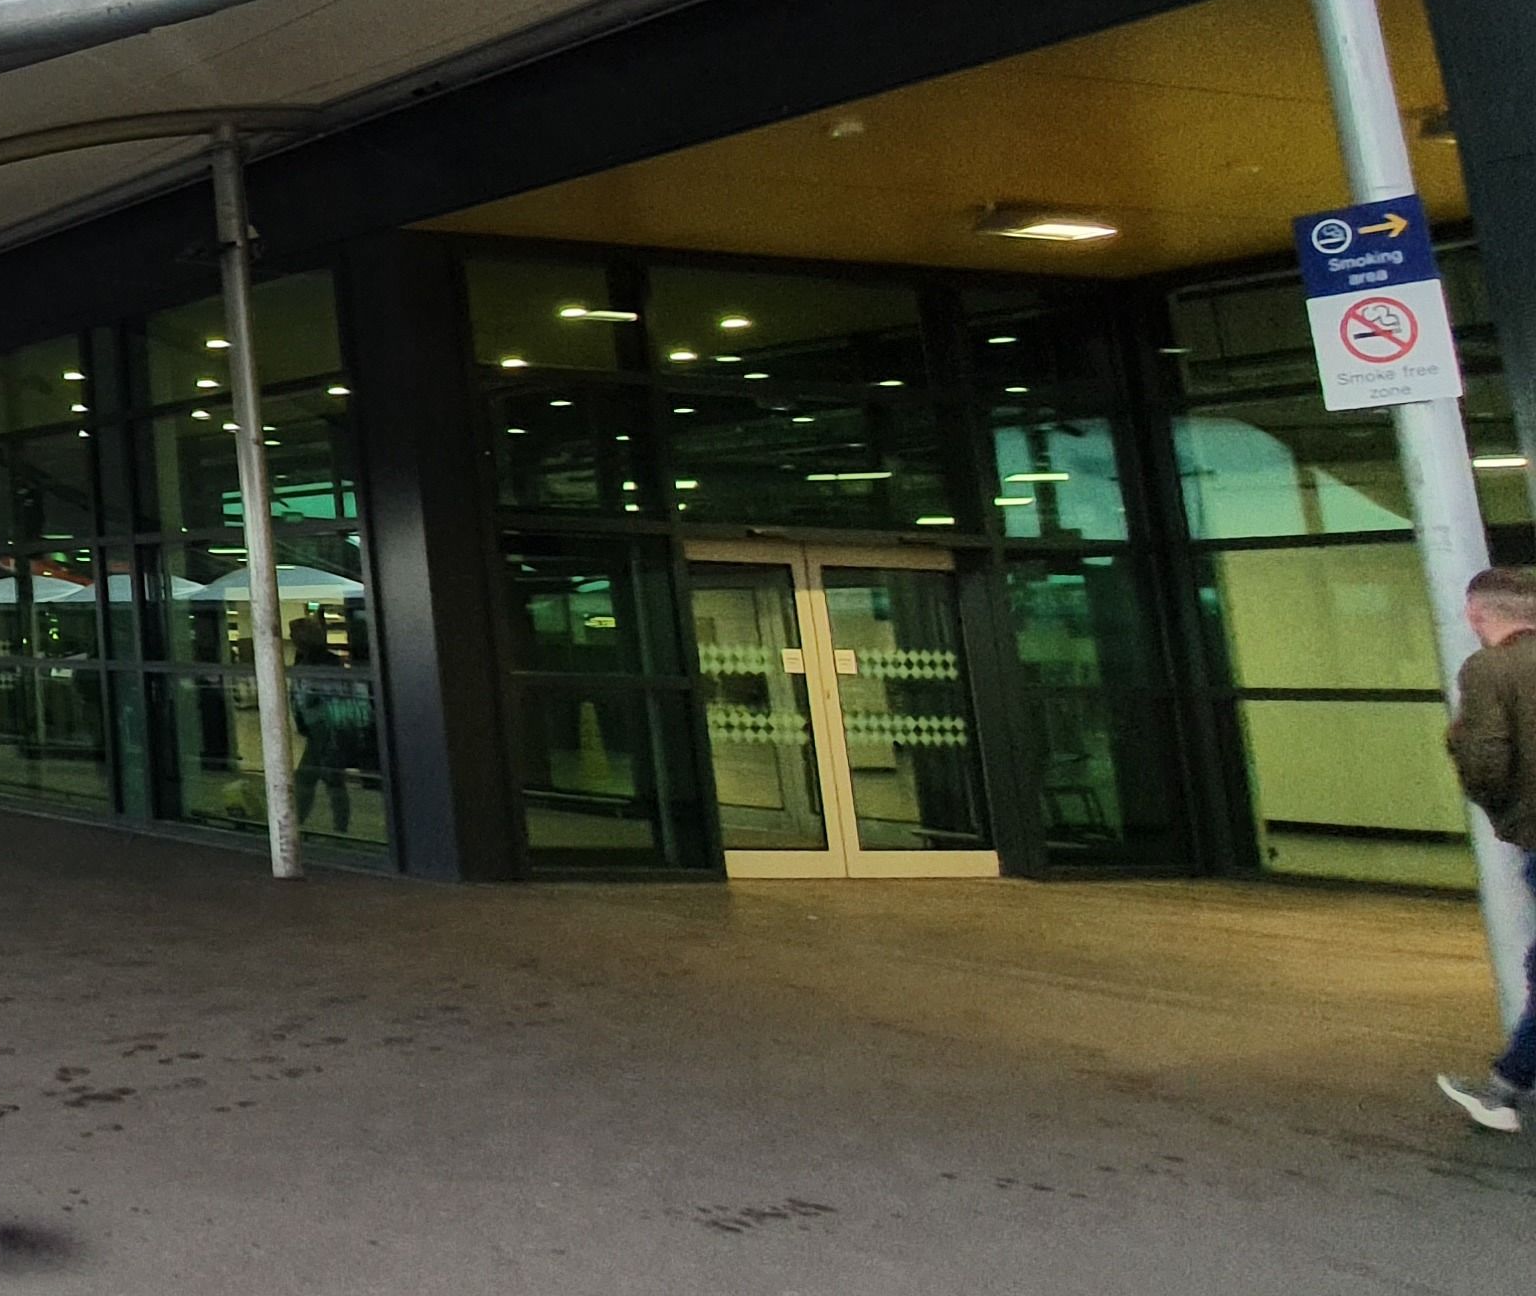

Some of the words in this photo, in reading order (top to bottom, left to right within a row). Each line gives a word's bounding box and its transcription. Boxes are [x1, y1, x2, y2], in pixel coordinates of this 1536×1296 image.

[1328, 249, 1404, 273] Smoking
[1348, 269, 1388, 286] area
[1337, 367, 1396, 386] Smoke
[1402, 363, 1440, 379] free
[1370, 384, 1412, 399] zone
